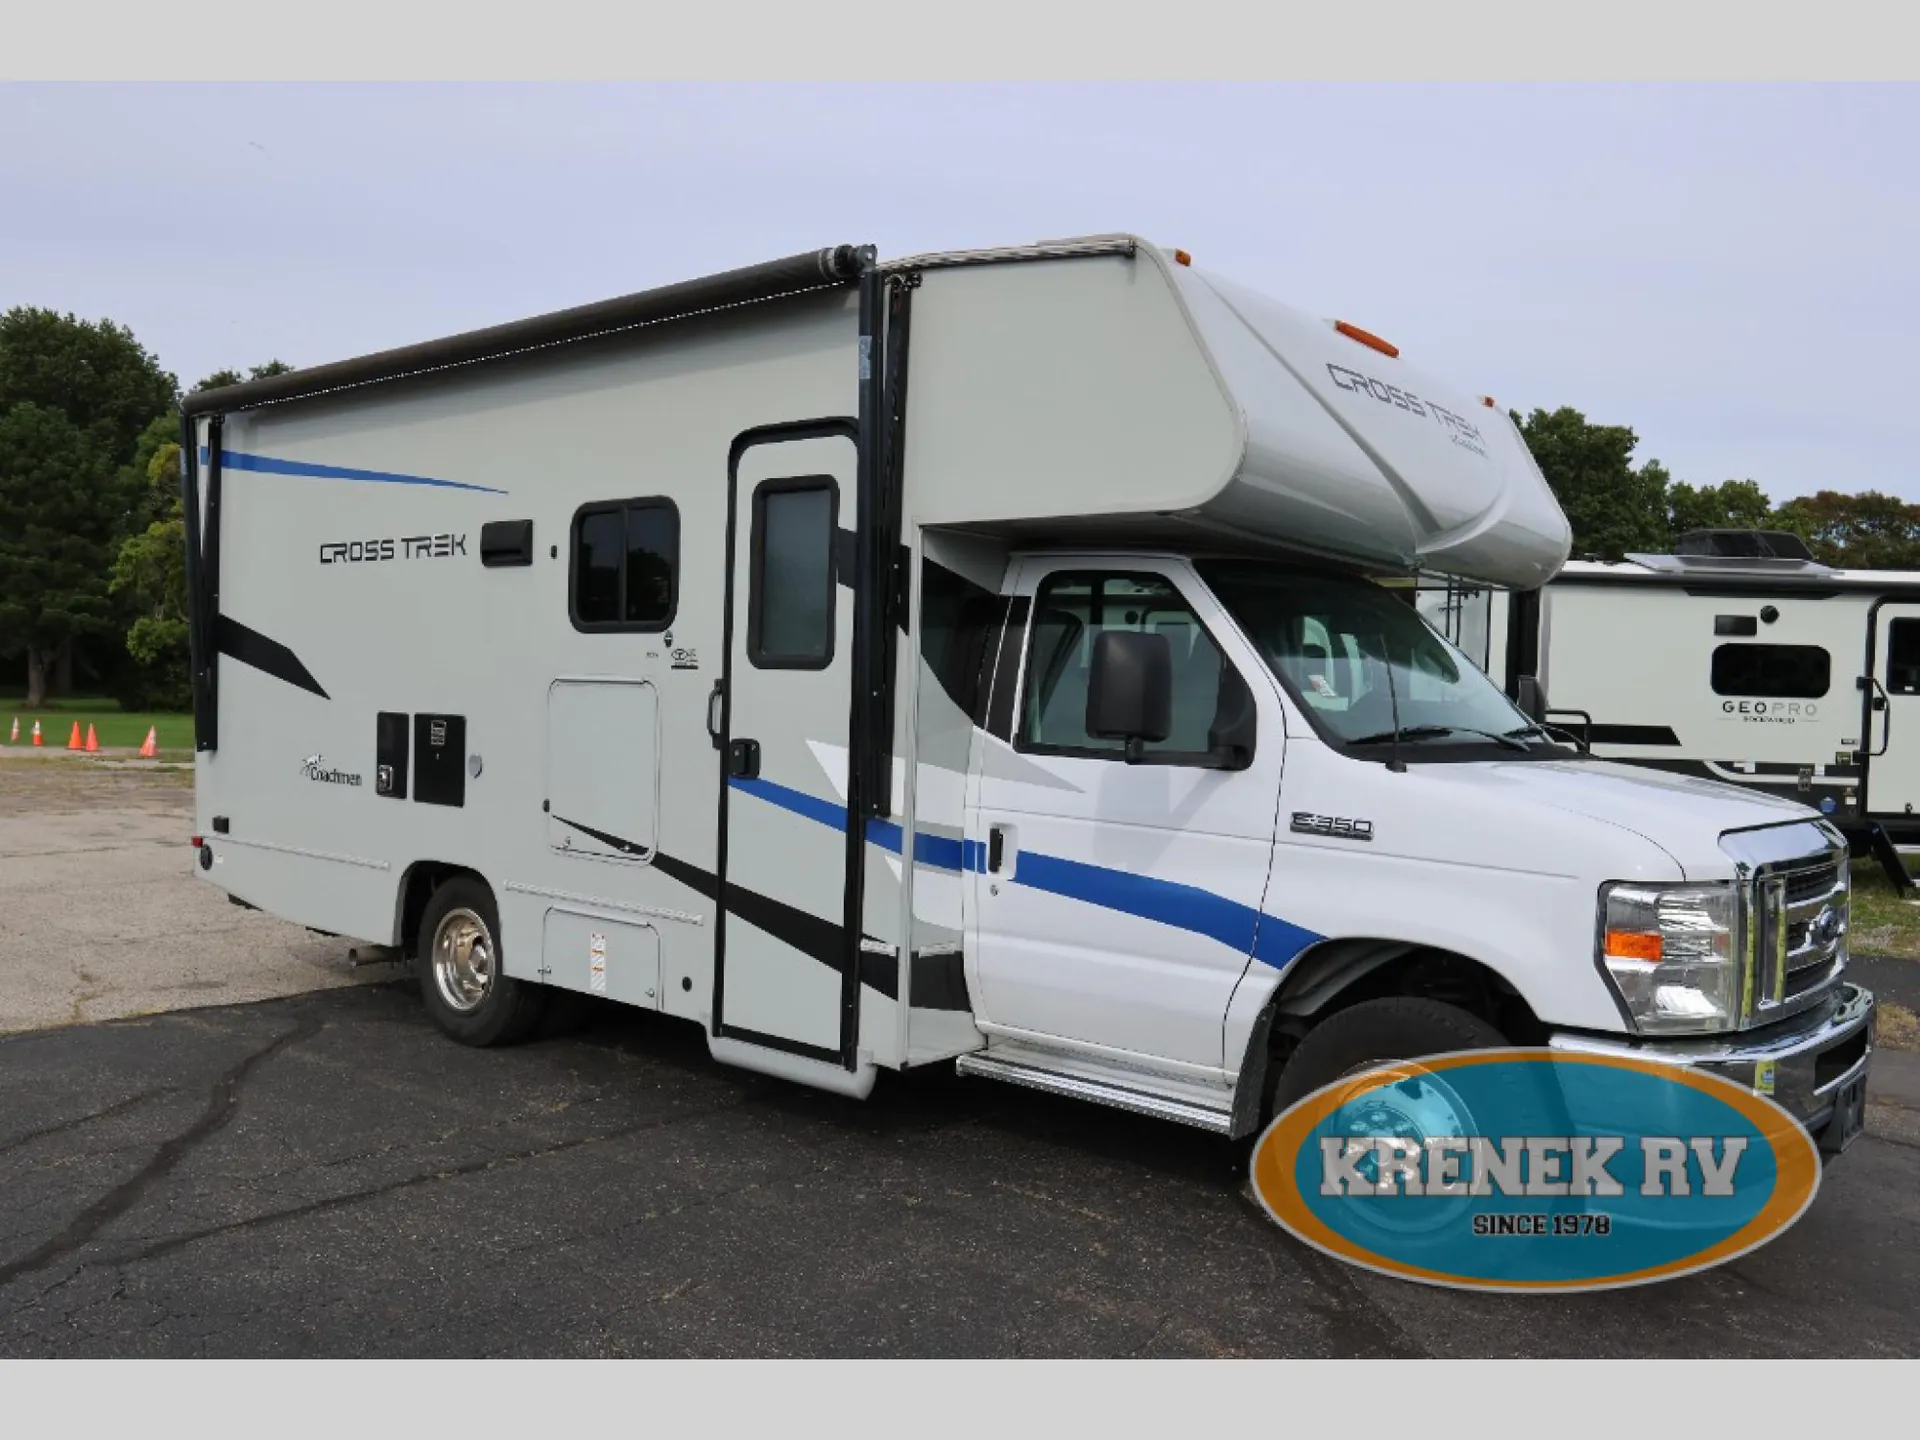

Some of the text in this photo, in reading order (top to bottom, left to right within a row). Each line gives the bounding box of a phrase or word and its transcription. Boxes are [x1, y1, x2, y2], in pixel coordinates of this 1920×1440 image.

[1325, 363, 1427, 418] CROSS
[320, 533, 468, 564] CROSS TREK
[310, 766, 363, 787] Coachmen
